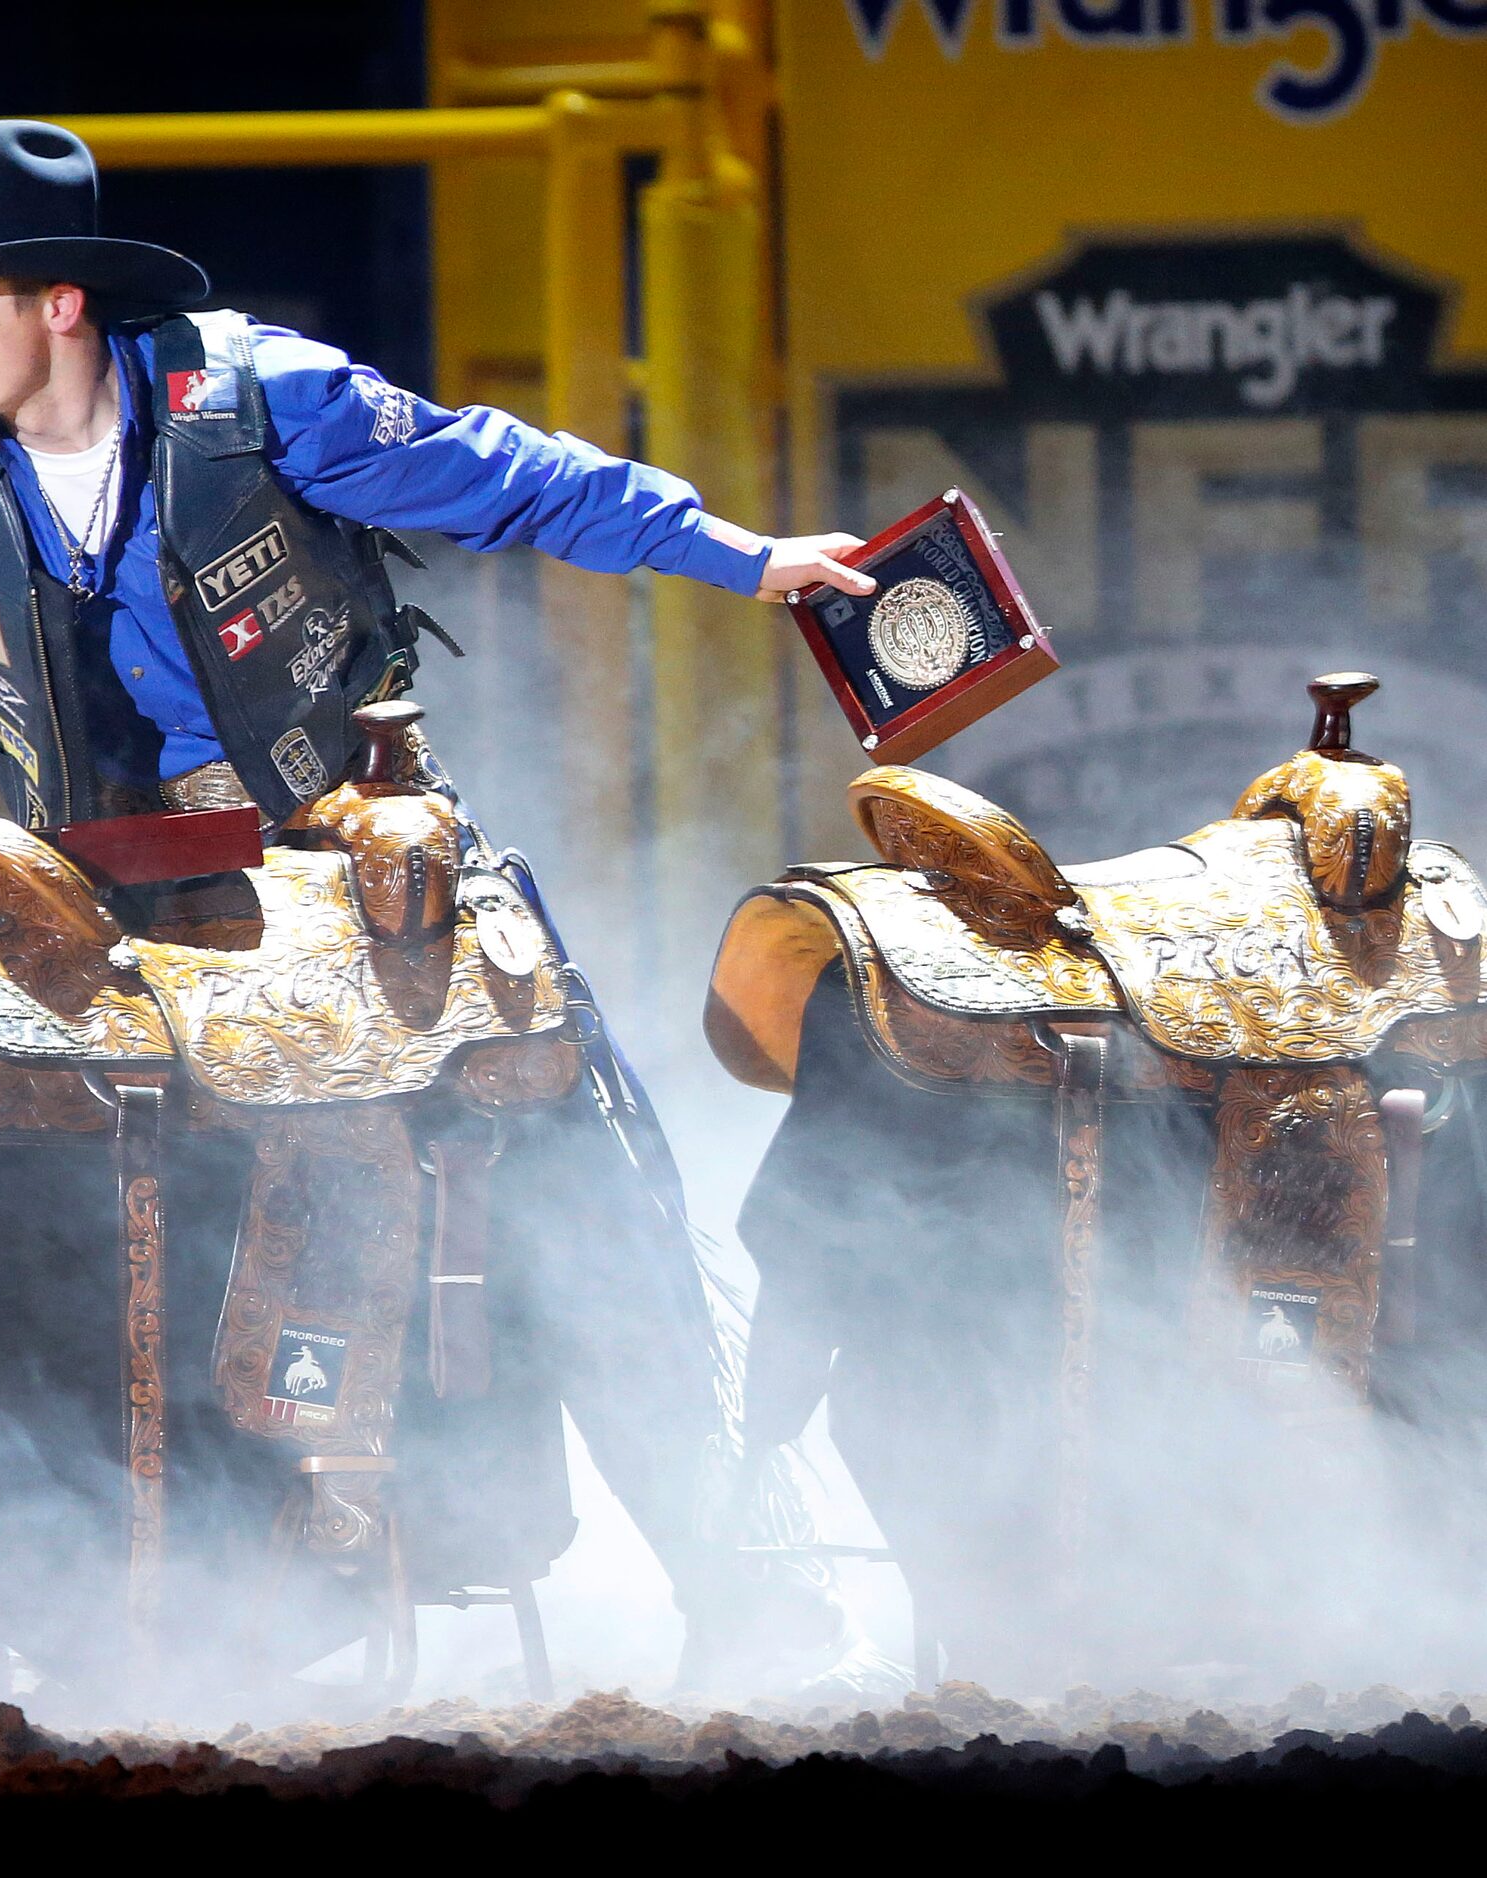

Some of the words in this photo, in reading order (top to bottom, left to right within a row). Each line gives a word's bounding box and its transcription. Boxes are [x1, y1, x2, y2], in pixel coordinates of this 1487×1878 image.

[1034, 281, 1397, 405] Wrangler
[202, 532, 282, 598] YETI
[257, 575, 304, 625] TXS
[914, 538, 961, 585] WORLD
[952, 579, 986, 664] CHAMPION
[1252, 1290, 1318, 1304] PRORODEO
[281, 1328, 346, 1347] PRORODEO
[299, 1410, 329, 1422] PRCA
